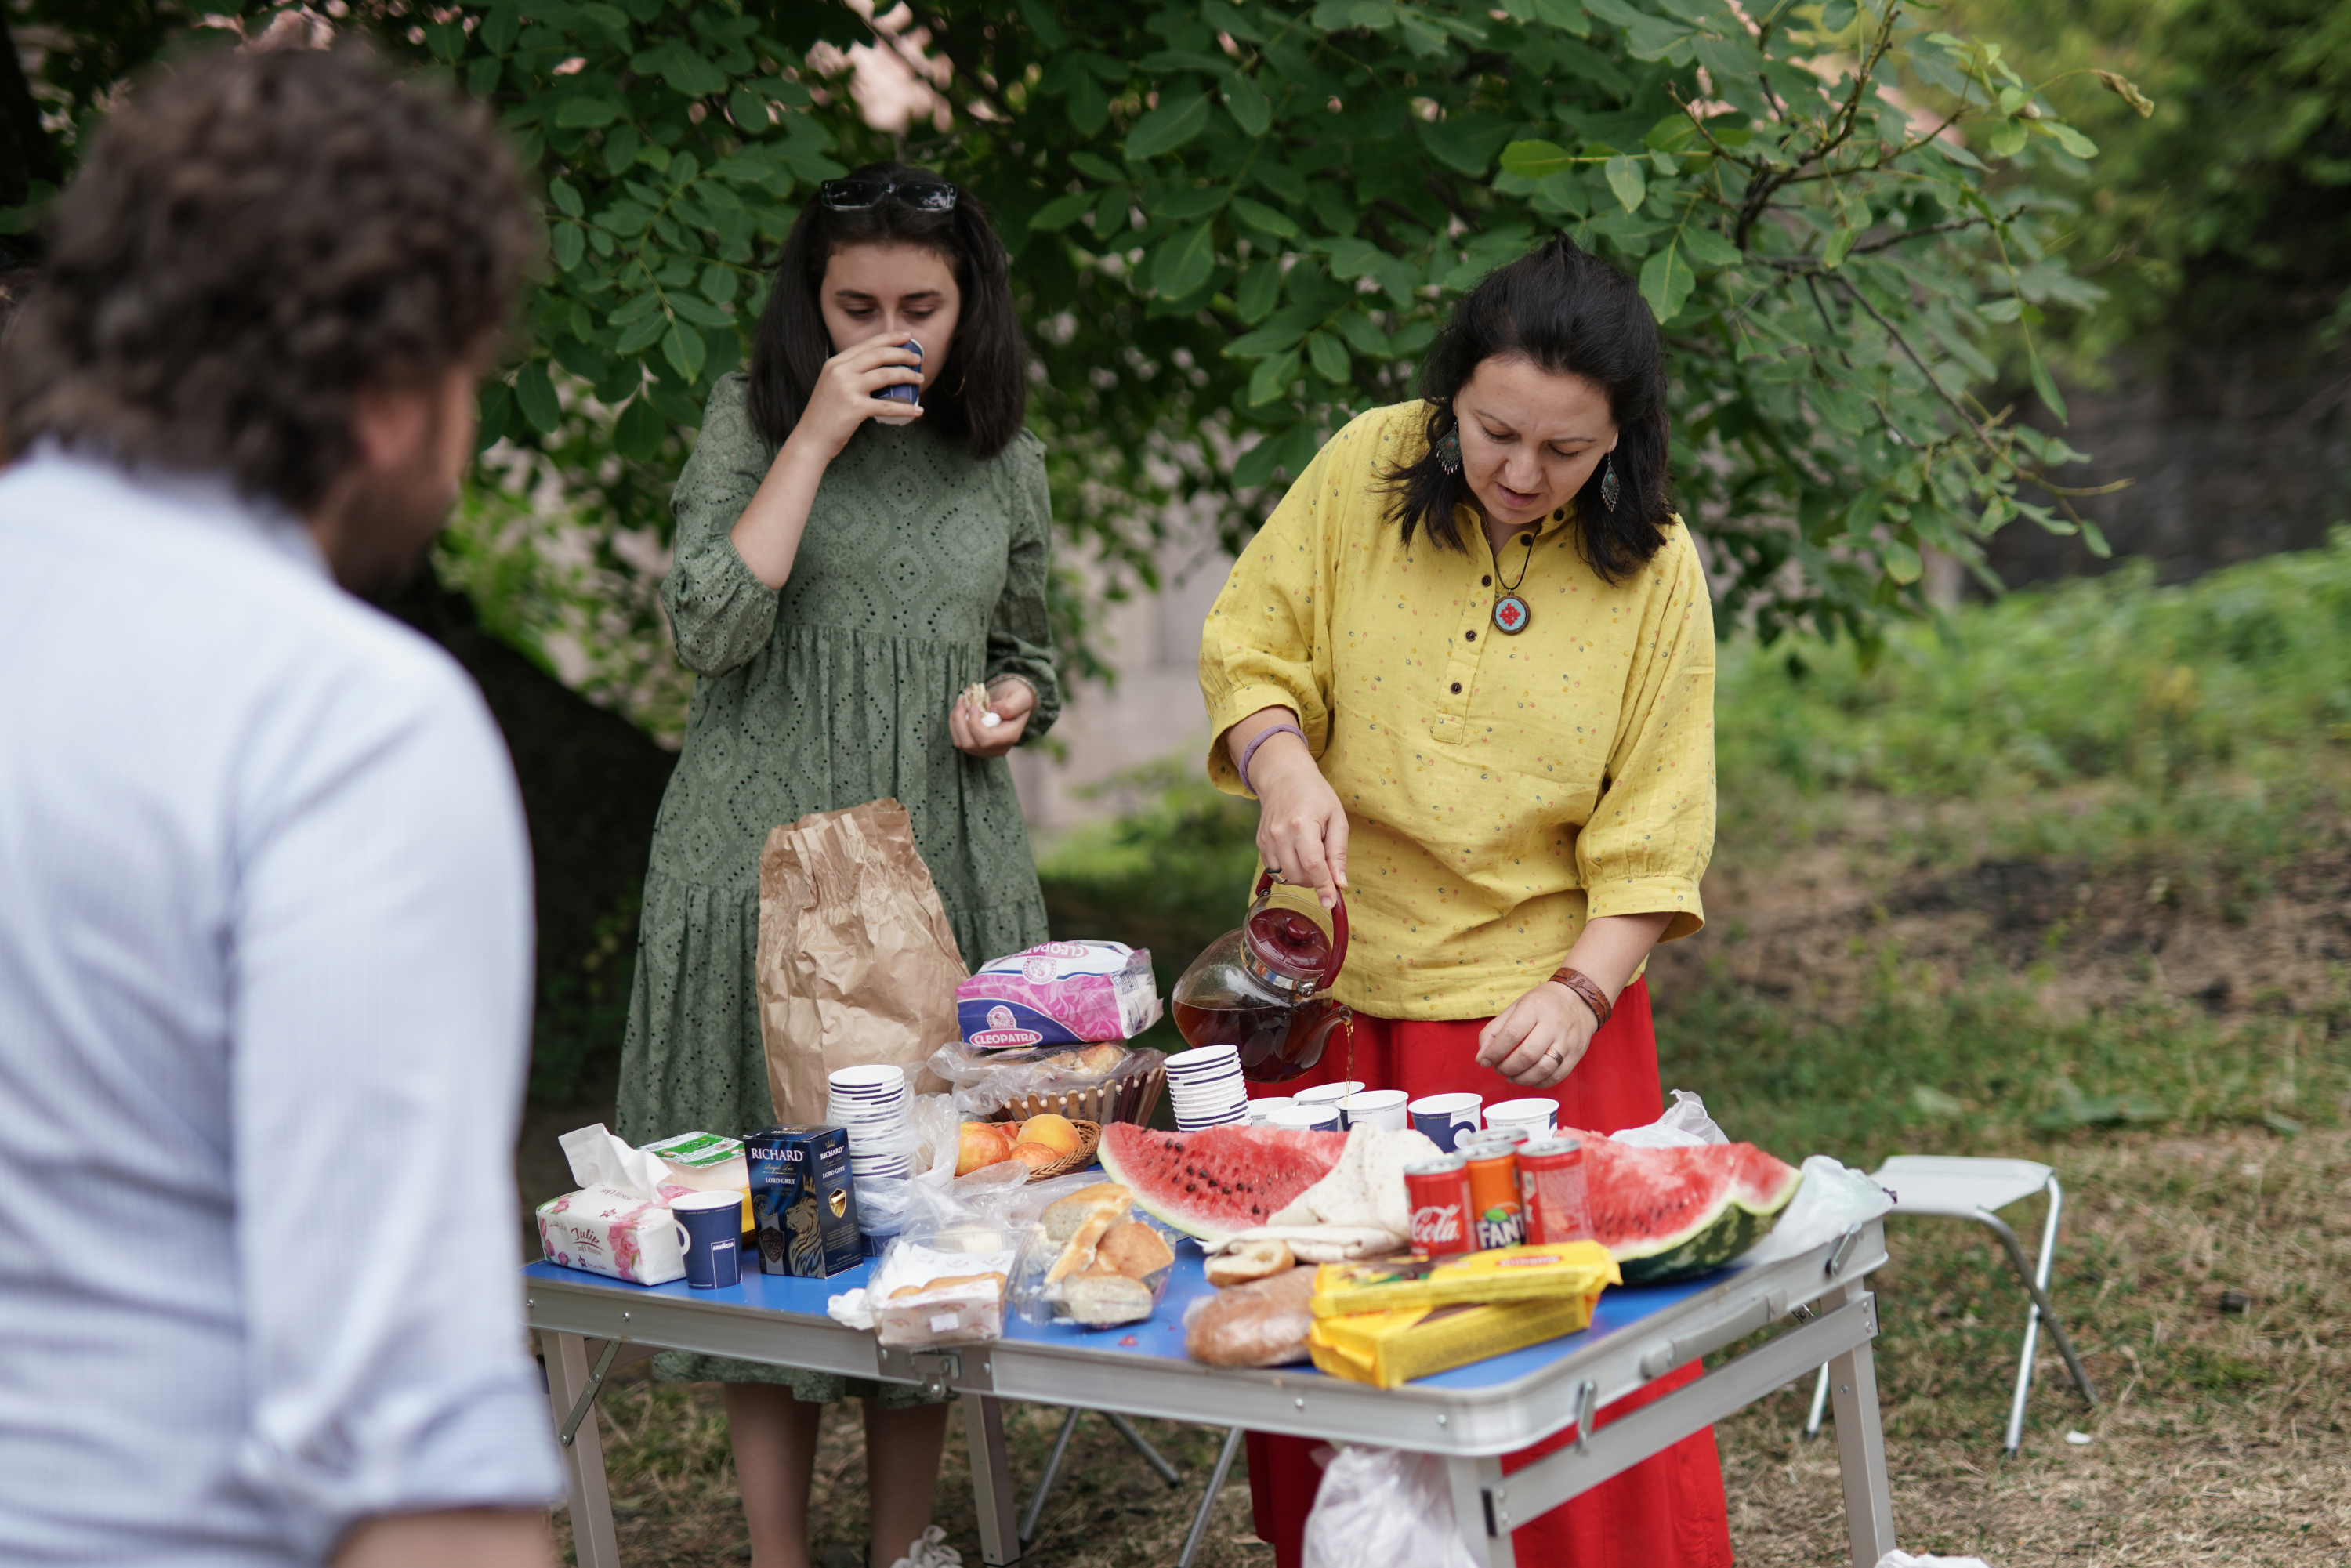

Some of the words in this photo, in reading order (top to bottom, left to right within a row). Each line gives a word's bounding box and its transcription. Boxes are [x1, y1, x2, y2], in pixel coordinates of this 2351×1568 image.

[974, 1033, 1037, 1045] CLEOPATRA
[751, 1148, 804, 1161] RICHARD
[820, 1146, 843, 1161] RICHARD
[764, 1163, 781, 1174] Royal
[822, 1170, 835, 1179] LORD
[835, 1165, 846, 1174] GREY
[712, 1242, 734, 1251] LAVAZZA
